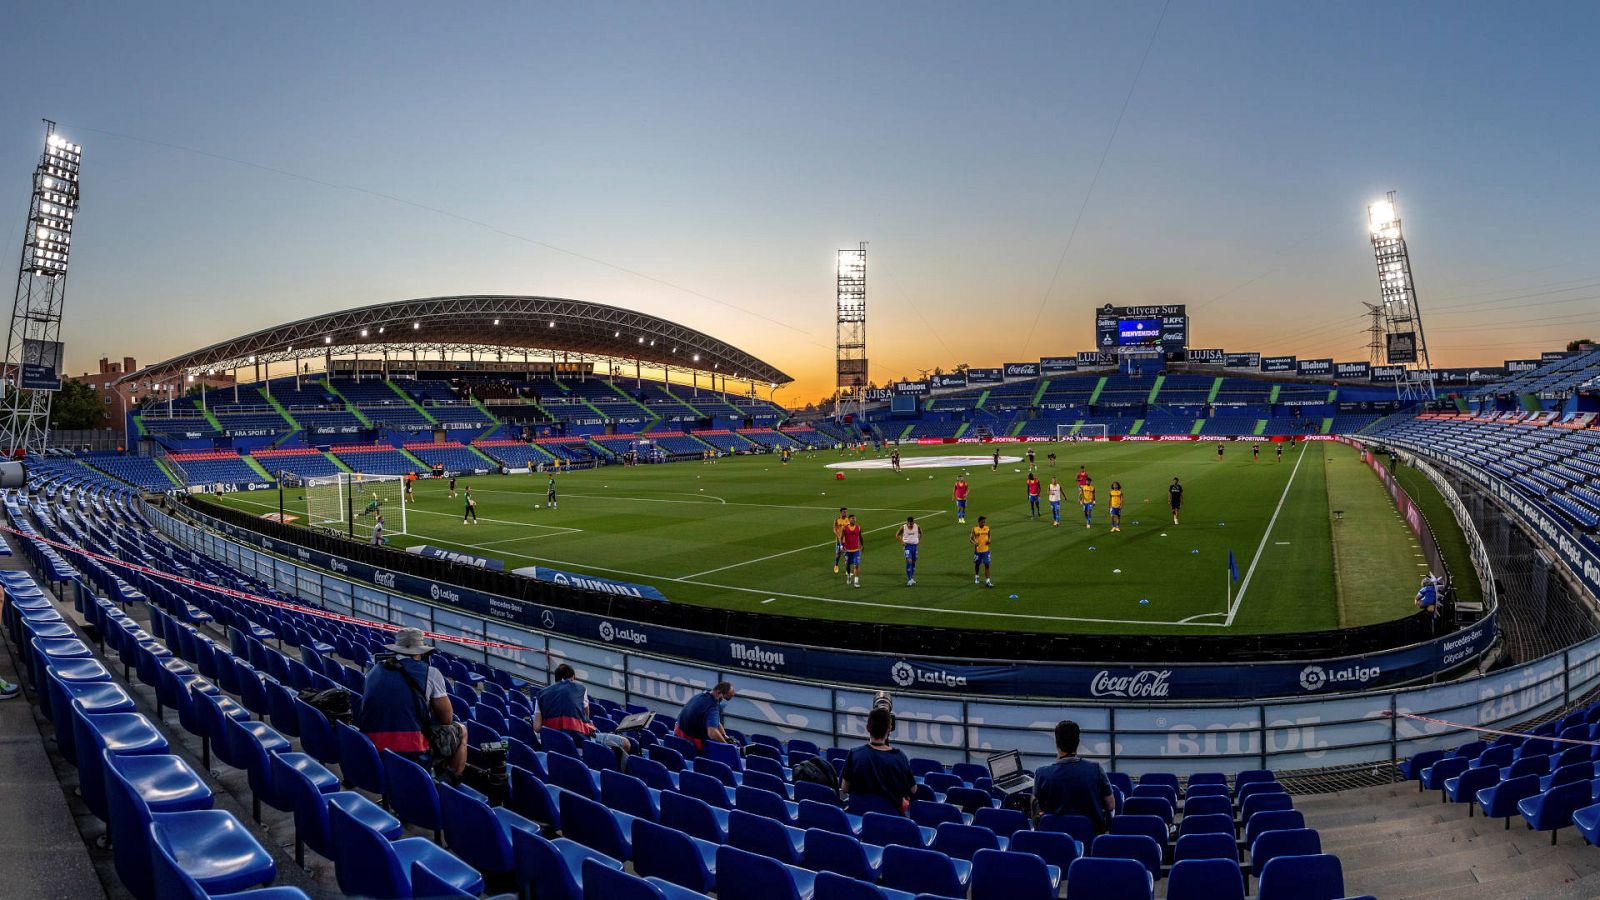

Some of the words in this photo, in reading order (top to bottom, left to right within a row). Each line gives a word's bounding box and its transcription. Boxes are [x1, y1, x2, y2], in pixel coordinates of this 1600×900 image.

[1126, 306, 1160, 316] Citycar
[1161, 305, 1178, 314] Sur
[1121, 330, 1159, 338] BIENVENIDOS
[1077, 353, 1113, 362] LUJISA
[1188, 350, 1223, 360] LUJISA
[1301, 361, 1329, 370] Mahou
[1338, 364, 1366, 373] Mahou
[1508, 361, 1537, 372] Mahou
[1374, 367, 1402, 376] Mahou
[898, 383, 926, 391] Mahou
[202, 483, 239, 494] LUSA
[440, 588, 460, 602] LaLiga
[489, 597, 523, 613] Mercedes-Benz
[615, 628, 647, 645] LaLiga
[1443, 629, 1483, 652] Mercedes-Benz
[730, 642, 785, 665] Mahou
[1443, 649, 1465, 665] Citycar
[1465, 646, 1475, 657] Sur
[917, 668, 967, 687] LaLiga
[1329, 664, 1382, 683] LaLiga
[1090, 669, 1173, 697] Coca-Cola
